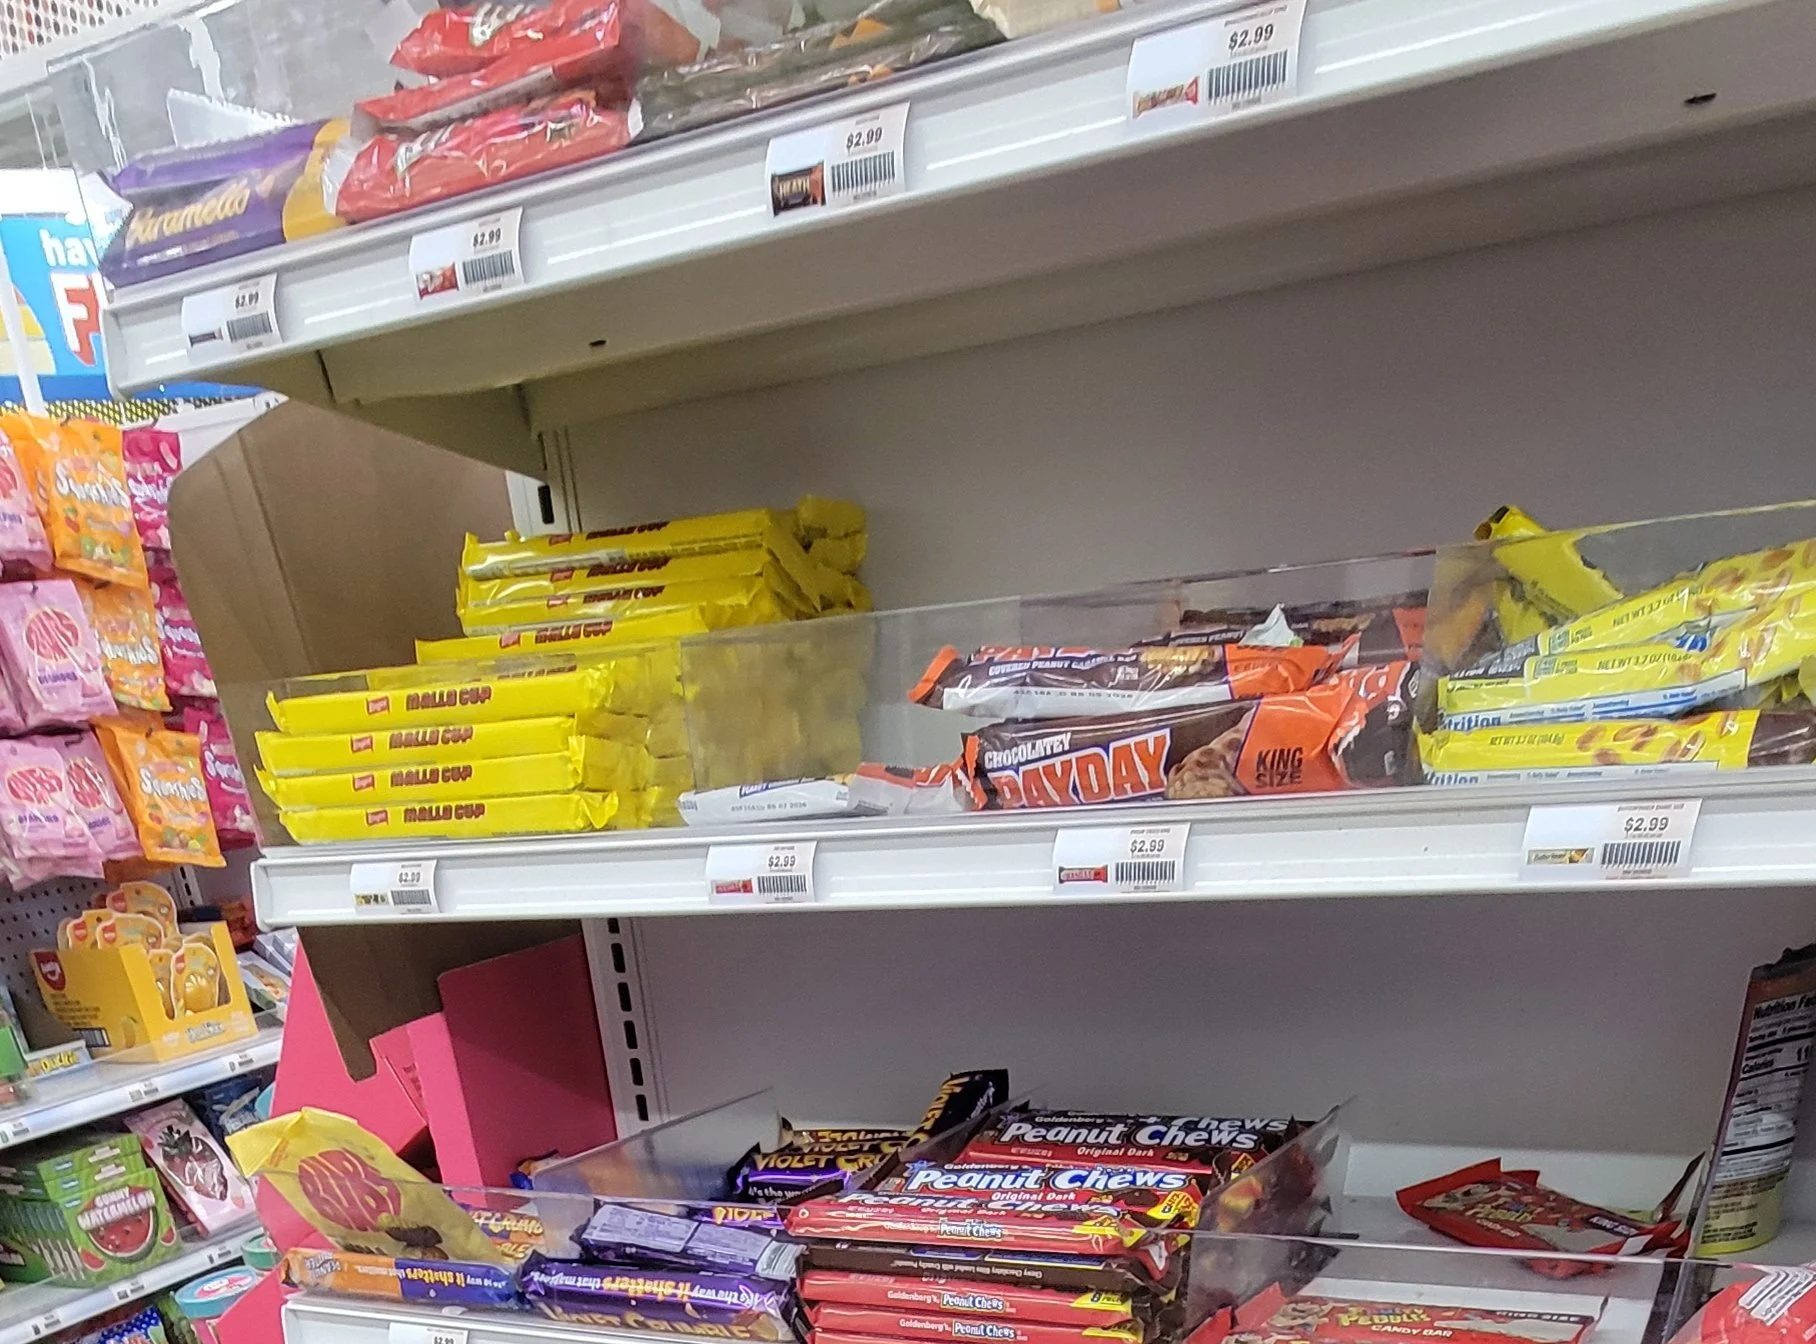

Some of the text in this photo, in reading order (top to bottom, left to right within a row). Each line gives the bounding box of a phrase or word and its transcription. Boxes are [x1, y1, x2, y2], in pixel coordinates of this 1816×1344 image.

[1227, 24, 1274, 52] $2.99
[846, 127, 882, 150] $2.99
[472, 228, 501, 249] $2.99
[988, 658, 1072, 677] COVERED PEANUT
[406, 685, 492, 712] MALLO CUP
[389, 725, 474, 750] MALLO CUP
[983, 733, 1072, 769] CHOCOLATEY
[1255, 746, 1304, 771] KING
[390, 764, 473, 788] MALLO CUP
[987, 727, 1172, 809] PAYDAY
[1255, 770, 1302, 788] SIZE
[403, 802, 486, 824] MALLO CUP
[1624, 816, 1669, 833] $2.99
[1129, 838, 1165, 856] $2.99
[766, 853, 797, 869] $2.99
[1000, 1121, 1262, 1151] Peanut Chews
[1076, 1147, 1155, 1157] Original Dark
[752, 1154, 835, 1172] VIOLET
[905, 1167, 1188, 1192] Peanut Chews
[839, 1192, 1122, 1217] Peanut Chews
[991, 1190, 1076, 1202] Original Dark
[939, 1222, 1002, 1239] Peanut Chews
[602, 1275, 677, 1302] shatters
[941, 1293, 1004, 1311] Peanut Chews
[954, 1322, 1016, 1340] Peanut Chews
[1370, 1324, 1453, 1338] CANDY BAR
